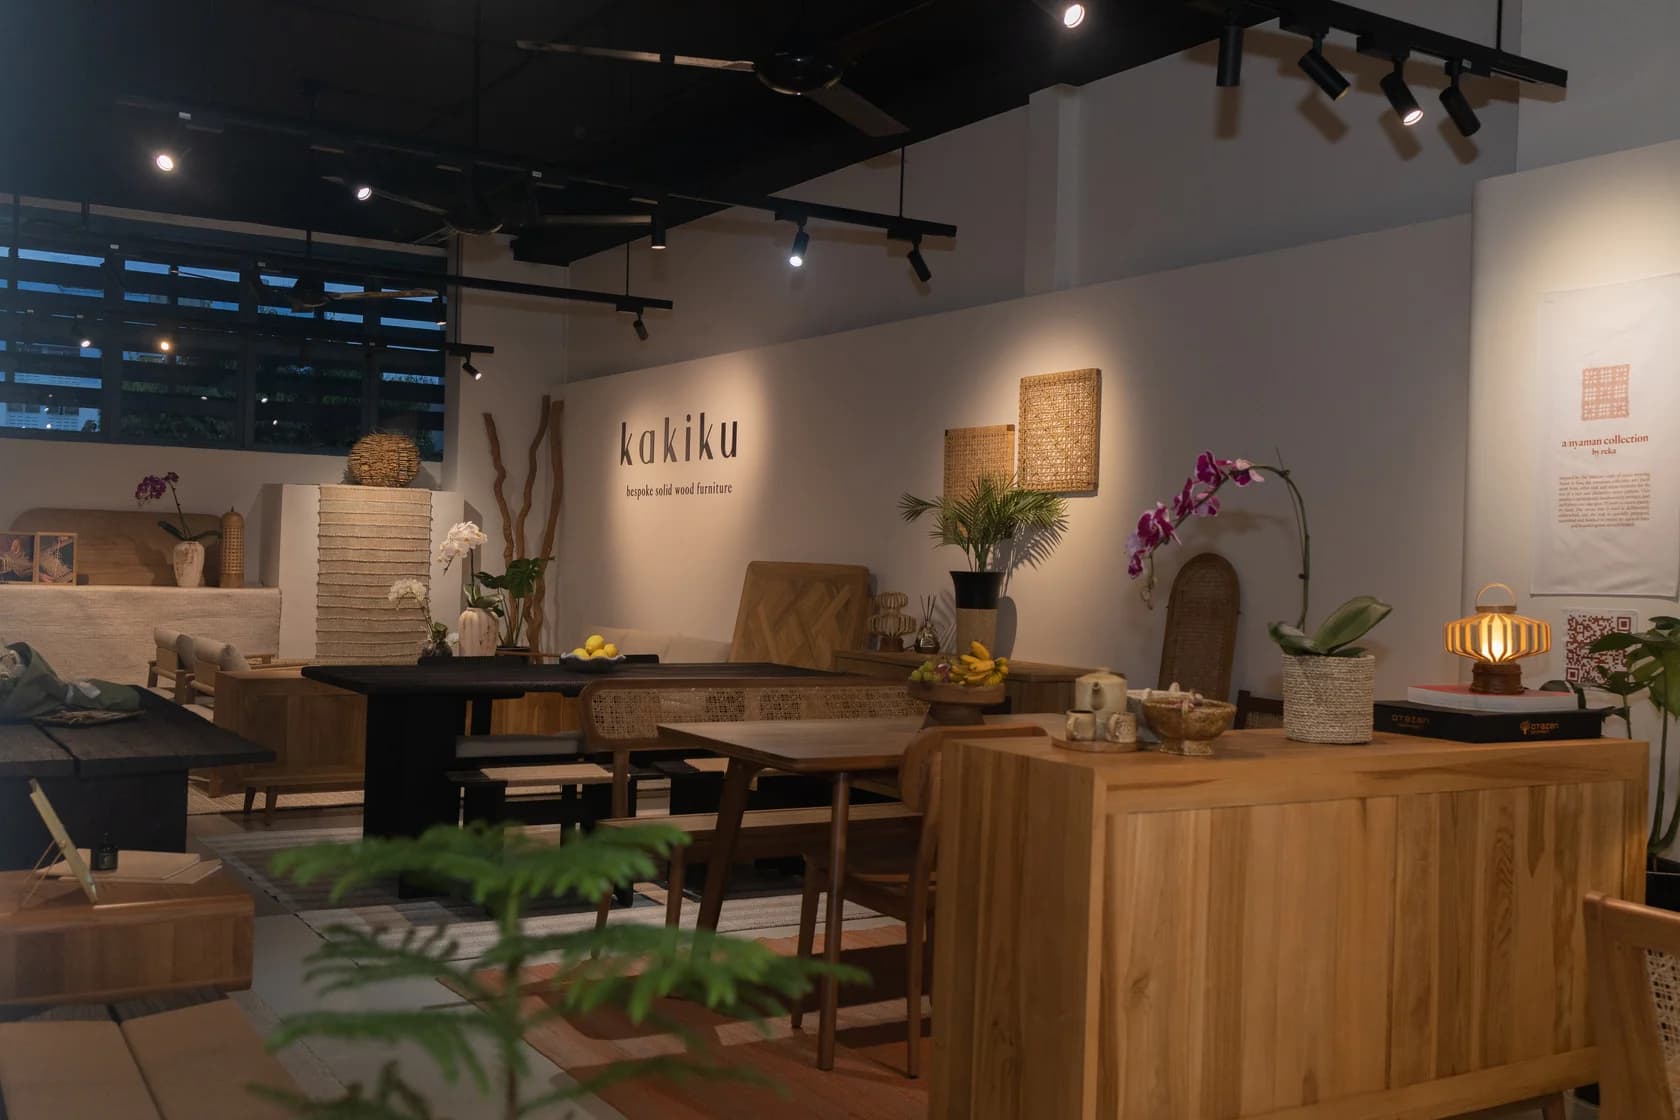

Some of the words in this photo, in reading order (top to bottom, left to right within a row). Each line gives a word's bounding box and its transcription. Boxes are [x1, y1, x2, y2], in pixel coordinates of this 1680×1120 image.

[620, 412, 738, 466] kakiku
[1561, 440, 1567, 448] a
[1569, 438, 1602, 450] nyaman
[1603, 434, 1649, 446] collection
[1591, 448, 1600, 456] by
[1600, 447, 1617, 456] reka
[626, 484, 654, 500] bespoke
[655, 483, 673, 497] solid
[674, 482, 695, 496] wood
[696, 481, 733, 495] furniture
